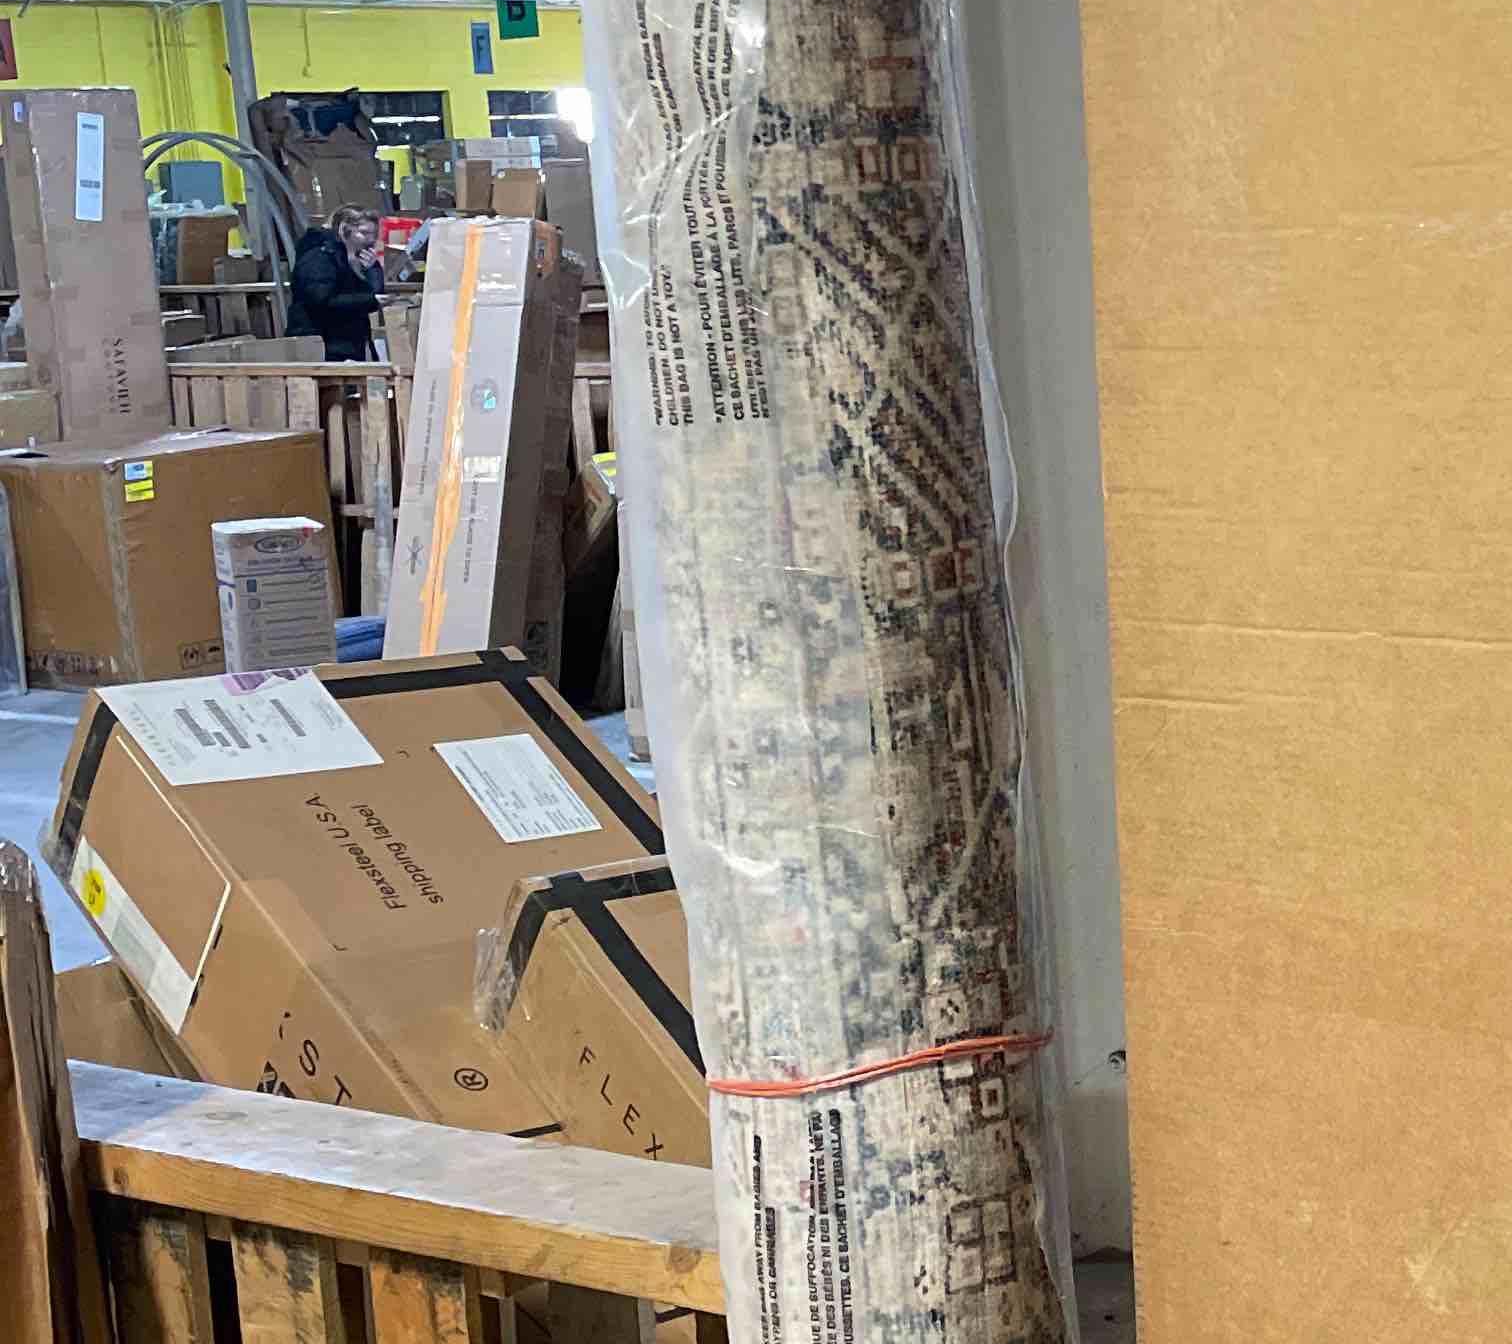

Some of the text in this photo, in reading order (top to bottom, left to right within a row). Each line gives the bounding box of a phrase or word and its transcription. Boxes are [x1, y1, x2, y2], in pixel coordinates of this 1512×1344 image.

[683, 204, 698, 236] TOUT
[704, 211, 716, 227] LA
[722, 206, 739, 250] PARCS
[653, 301, 664, 328] NOT
[667, 303, 676, 312] A
[697, 292, 712, 330] POUR
[657, 332, 666, 351] DO
[669, 317, 680, 343] NOT
[674, 348, 684, 359] IS
[678, 363, 689, 392] BAG
[724, 347, 741, 398] SACHET
[682, 396, 693, 425] THIS
[733, 402, 744, 420] CE
[351, 804, 445, 905] shipping label
[338, 842, 408, 912] Flexsteel
[835, 1203, 849, 1252] SACHET
[822, 1246, 831, 1257] NI
[839, 1255, 850, 1272] CE
[809, 1305, 820, 1321] DE
[826, 1305, 836, 1329] DES
